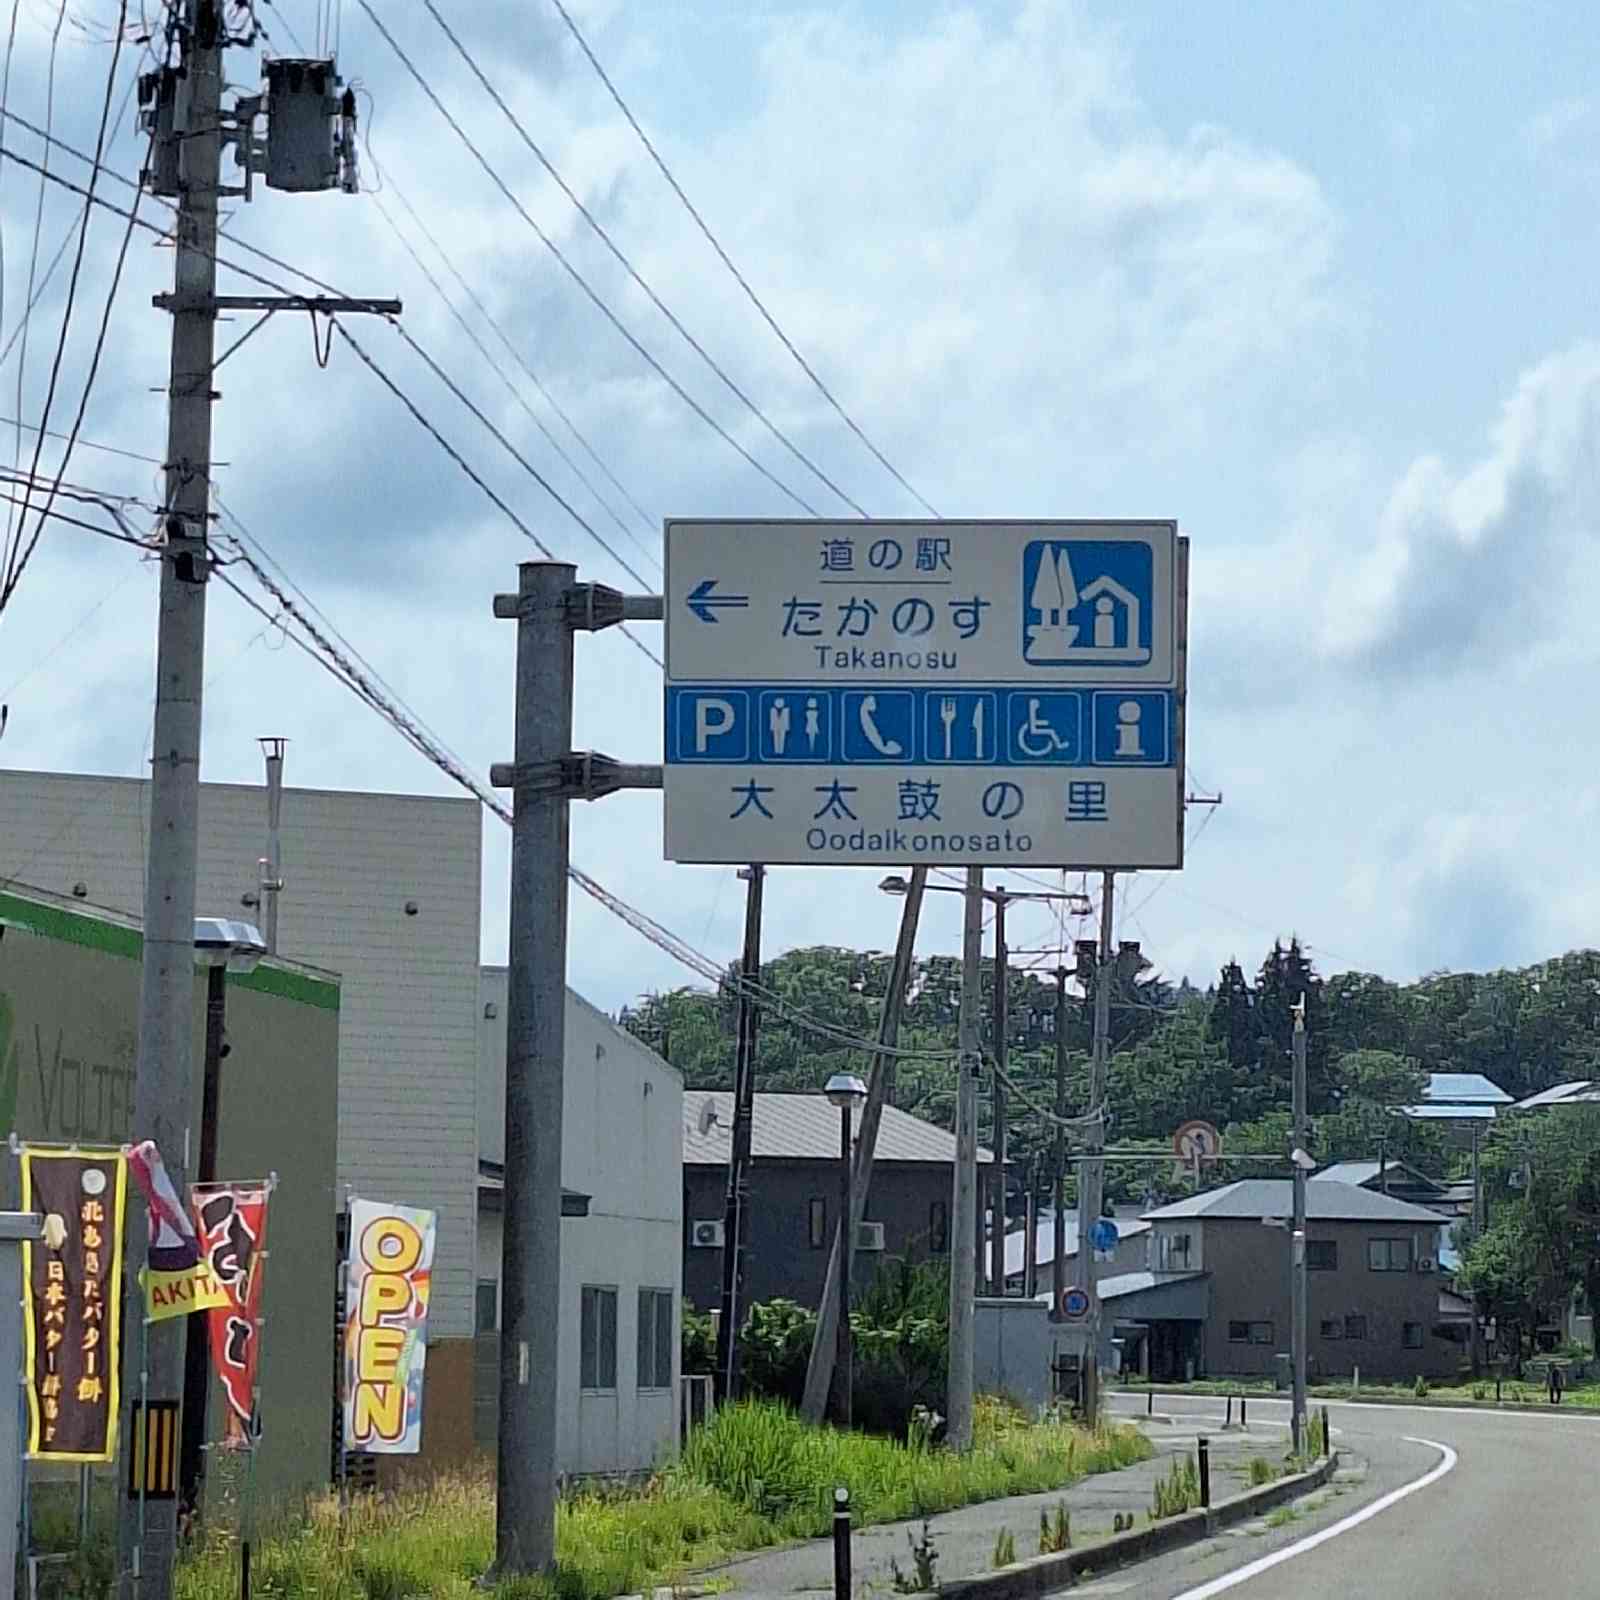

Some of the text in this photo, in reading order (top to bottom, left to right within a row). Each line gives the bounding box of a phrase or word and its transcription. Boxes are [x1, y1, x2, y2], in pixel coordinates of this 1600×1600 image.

[820, 538, 954, 573] 道の駅
[782, 595, 993, 640] たかのす
[814, 646, 958, 671] Takanosu
[696, 698, 735, 752] P
[730, 778, 1111, 823] 大太鼓の里
[353, 1216, 422, 1440] OPEN
